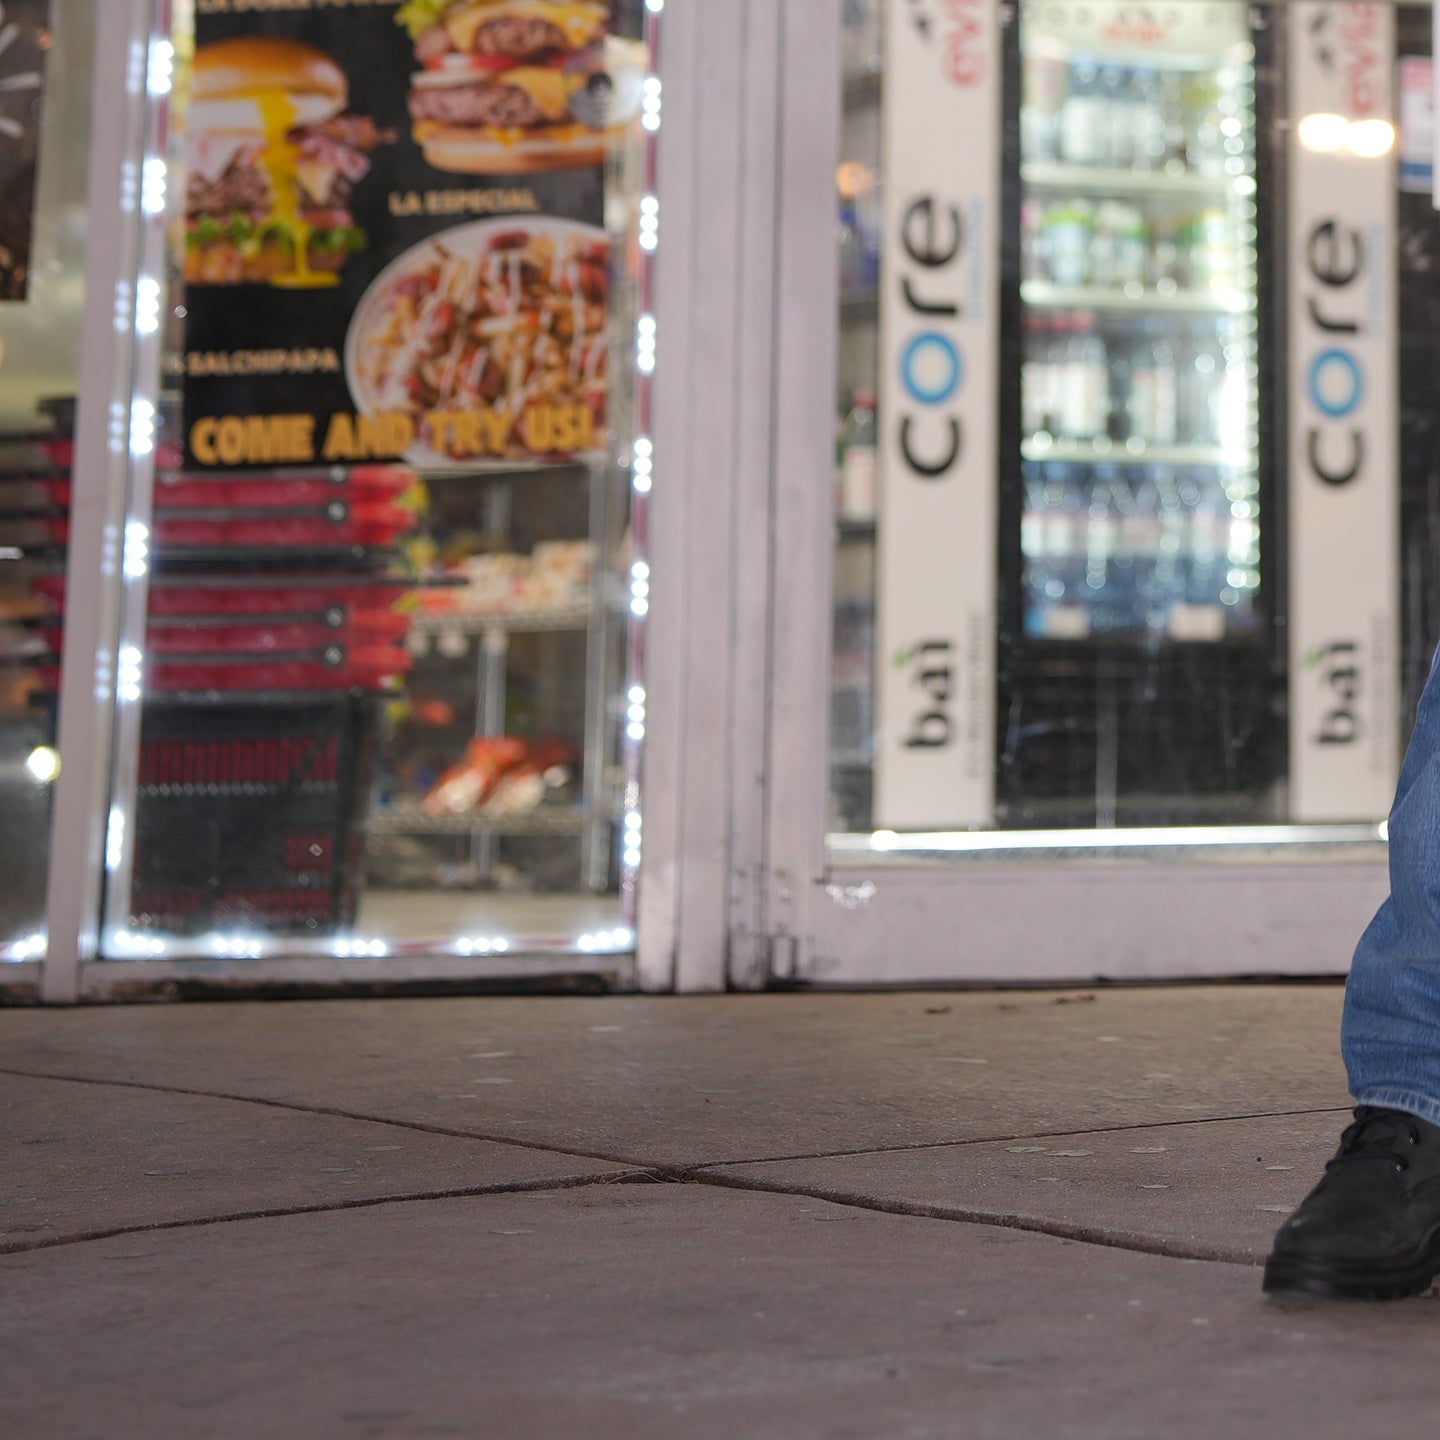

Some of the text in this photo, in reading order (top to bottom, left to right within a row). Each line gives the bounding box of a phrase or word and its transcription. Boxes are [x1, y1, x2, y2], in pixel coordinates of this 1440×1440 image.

[190, 404, 595, 465] COME AND TRY US!
[898, 197, 961, 478] core
[1306, 218, 1365, 488] core
